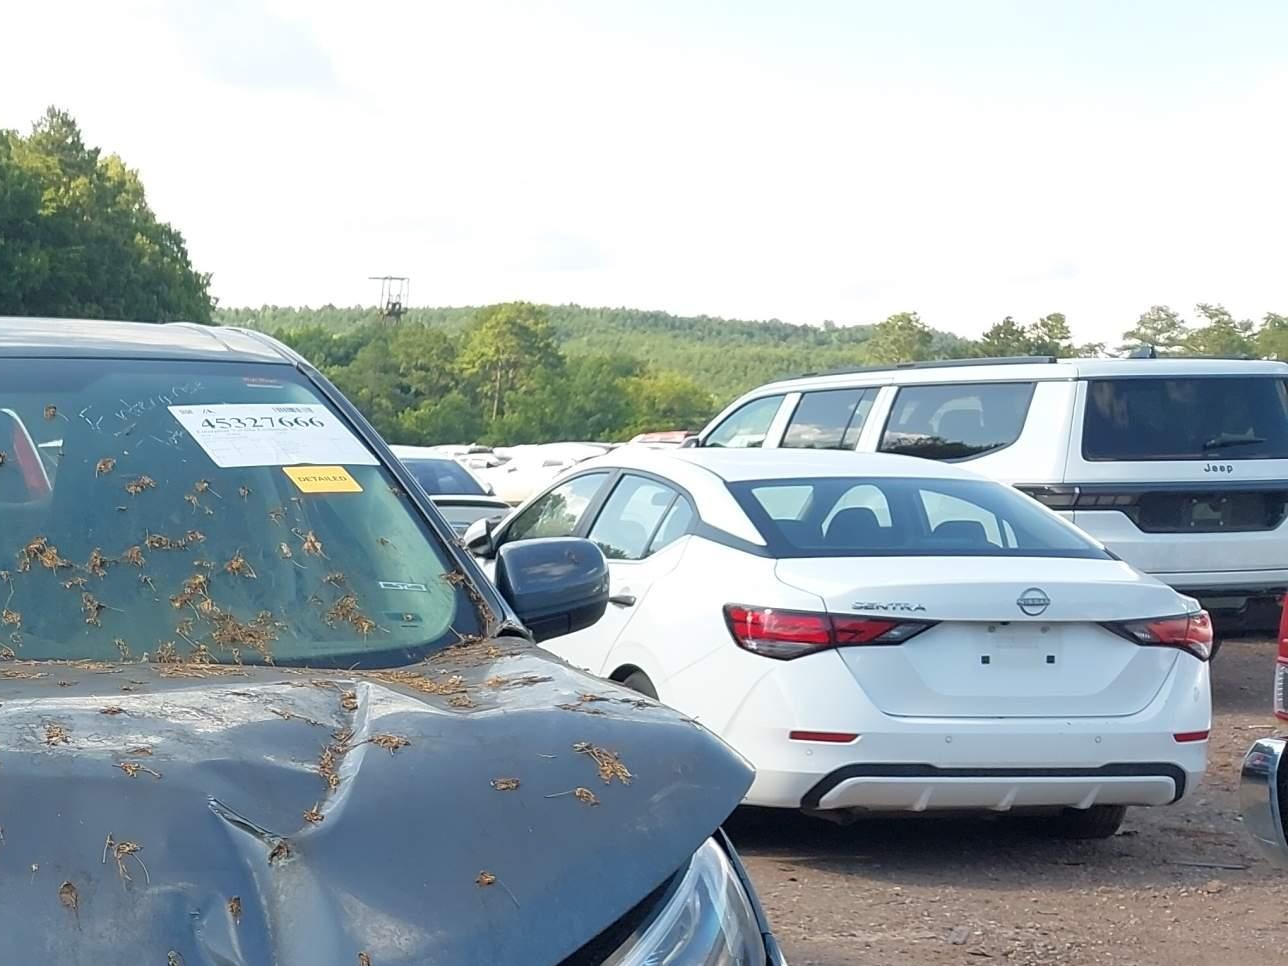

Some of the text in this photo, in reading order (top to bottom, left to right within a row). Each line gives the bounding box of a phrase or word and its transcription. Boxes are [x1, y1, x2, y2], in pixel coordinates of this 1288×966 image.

[201, 416, 324, 429] 45327666
[1203, 463, 1233, 474] Jeep
[297, 475, 347, 483] DETAILED
[851, 601, 926, 611] SENTRA
